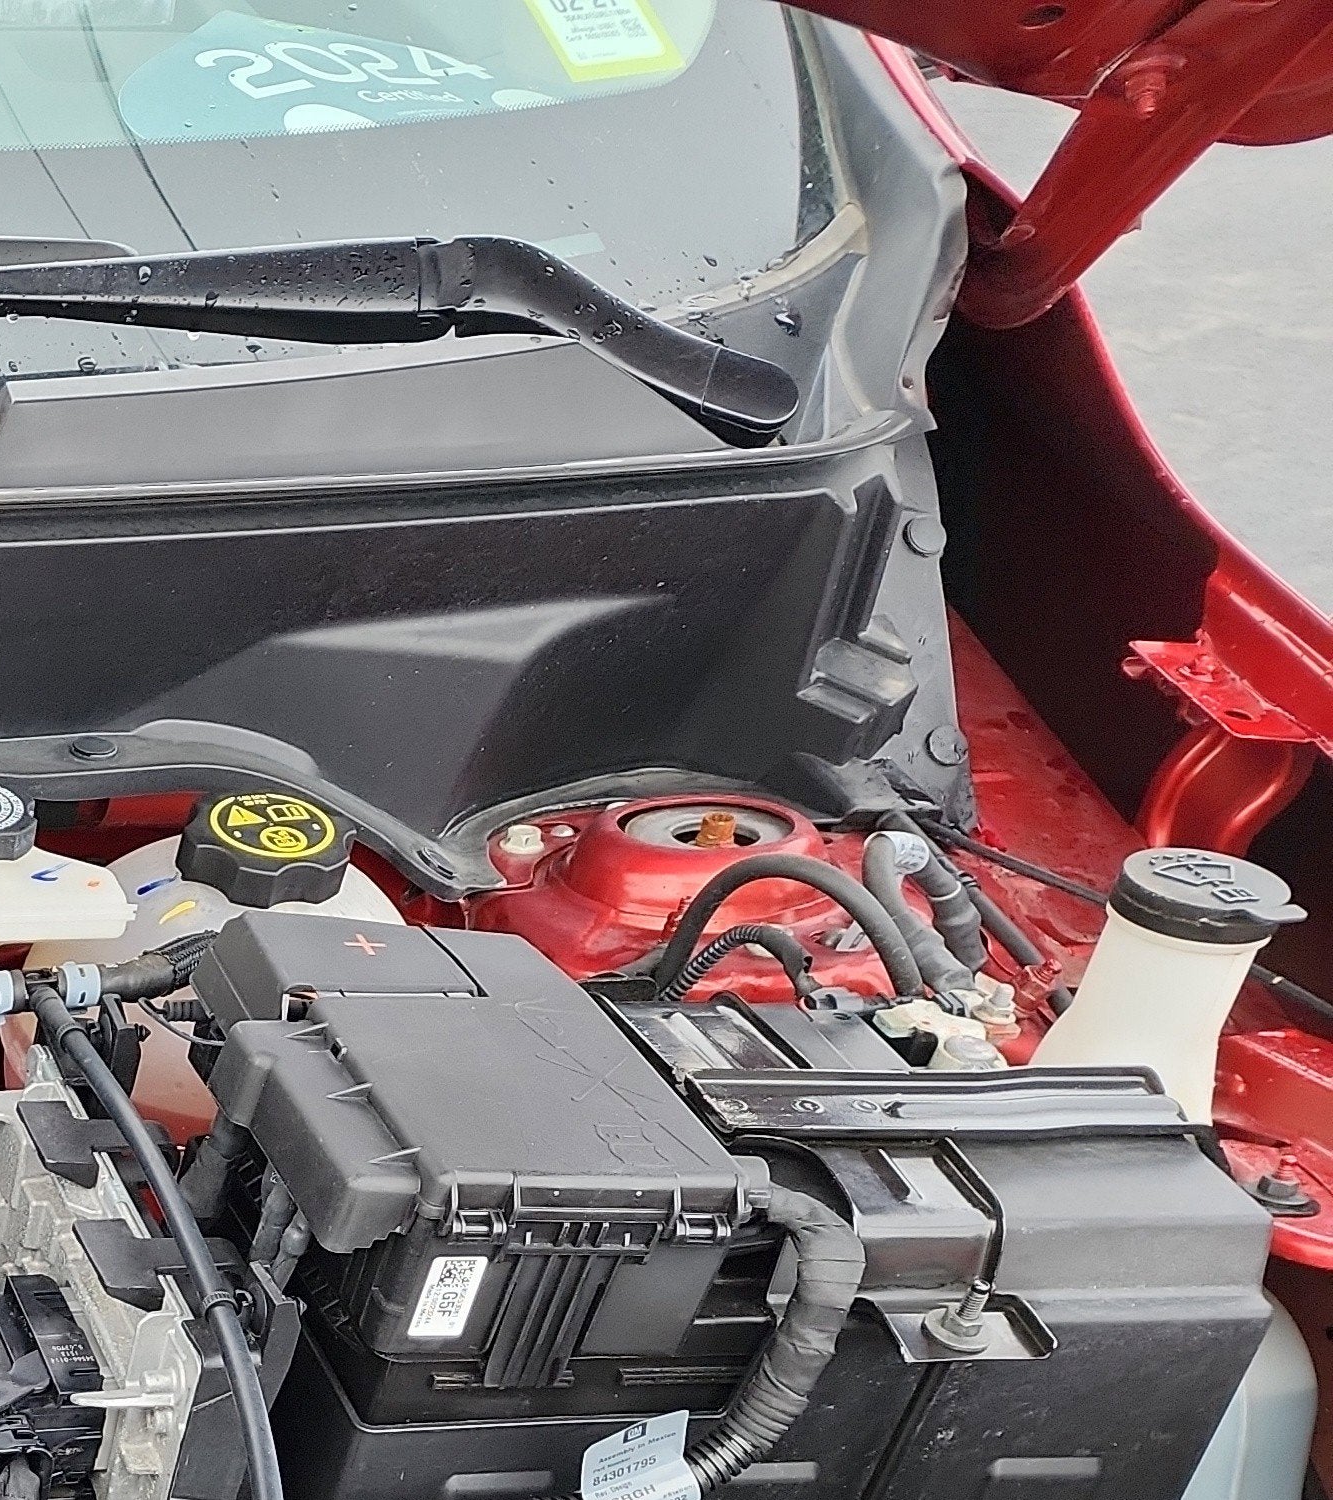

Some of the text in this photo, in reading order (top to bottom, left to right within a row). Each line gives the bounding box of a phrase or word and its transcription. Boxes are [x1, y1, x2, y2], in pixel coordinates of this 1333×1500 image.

[195, 42, 494, 99] 2024
[356, 90, 465, 104] Certified
[435, 1290, 458, 1317] G5F
[598, 1446, 635, 1464] Assembly
[648, 1432, 676, 1444] Mexico
[592, 1455, 657, 1487] 84301795
